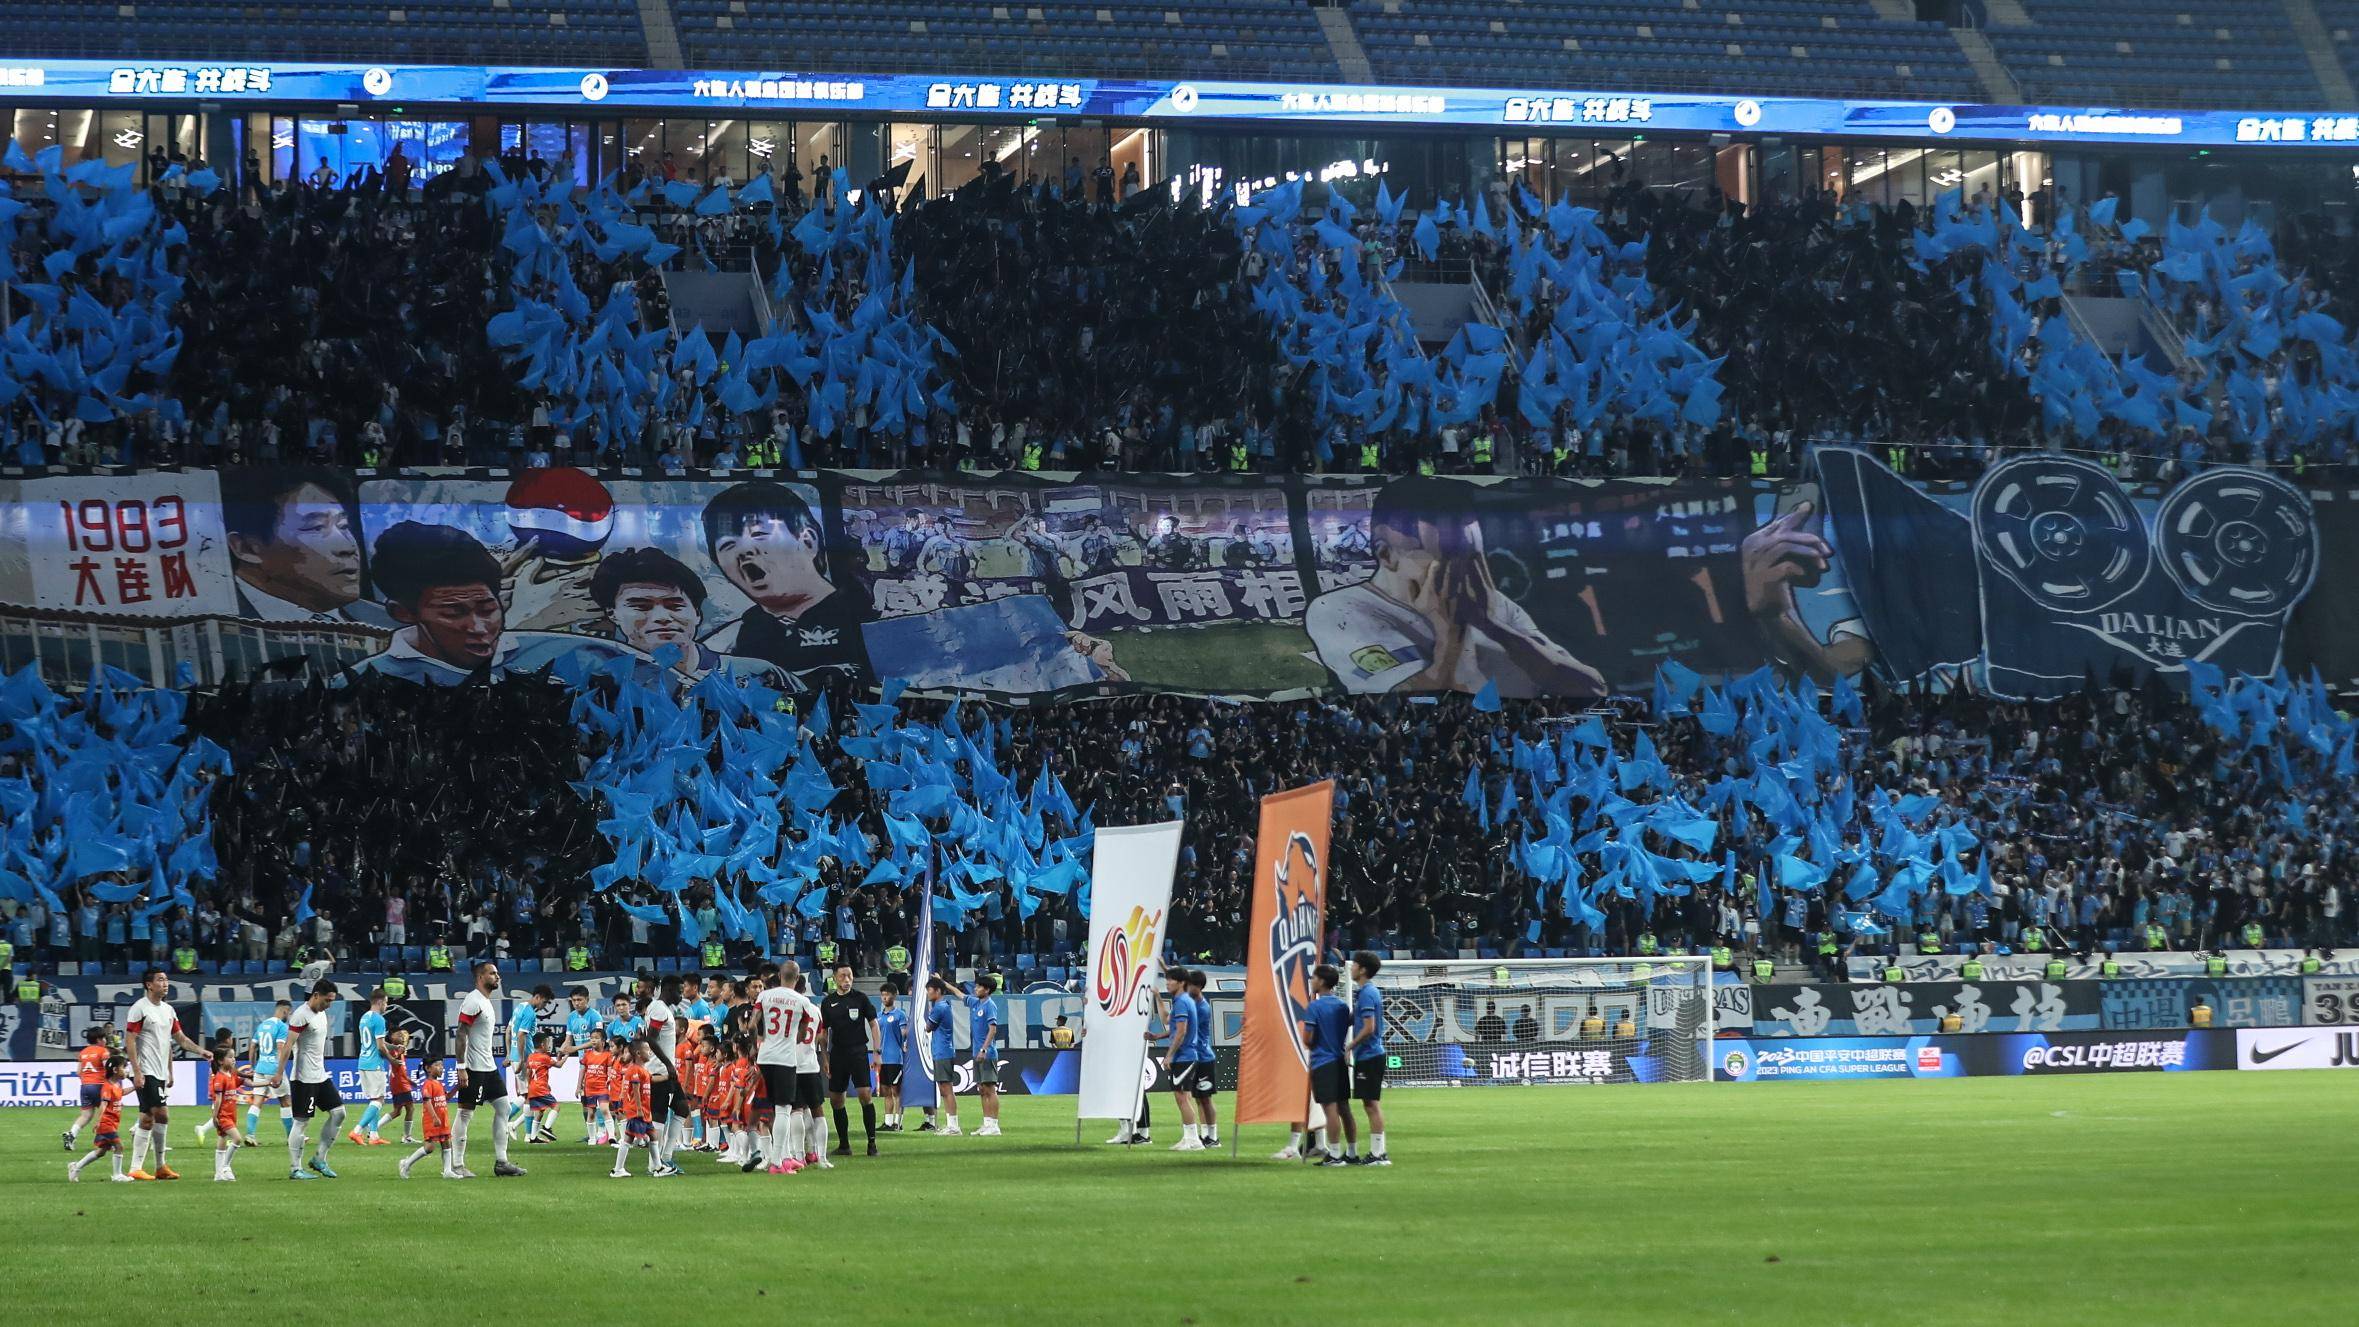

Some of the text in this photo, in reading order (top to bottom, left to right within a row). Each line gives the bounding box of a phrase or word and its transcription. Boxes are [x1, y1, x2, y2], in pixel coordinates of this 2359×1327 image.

[61, 494, 189, 554] 1983
[69, 548, 198, 605] 大连队
[2100, 611, 2223, 639] DALIAN
[767, 1006, 795, 1038] 31
[259, 1031, 273, 1054] 10
[2022, 1041, 2187, 1070] @CSL中超联赛
[1490, 1050, 1612, 1078] 诚信联赛
[1756, 1062, 1906, 1075] 2023 PING AN CFA SUPER LEAGUE
